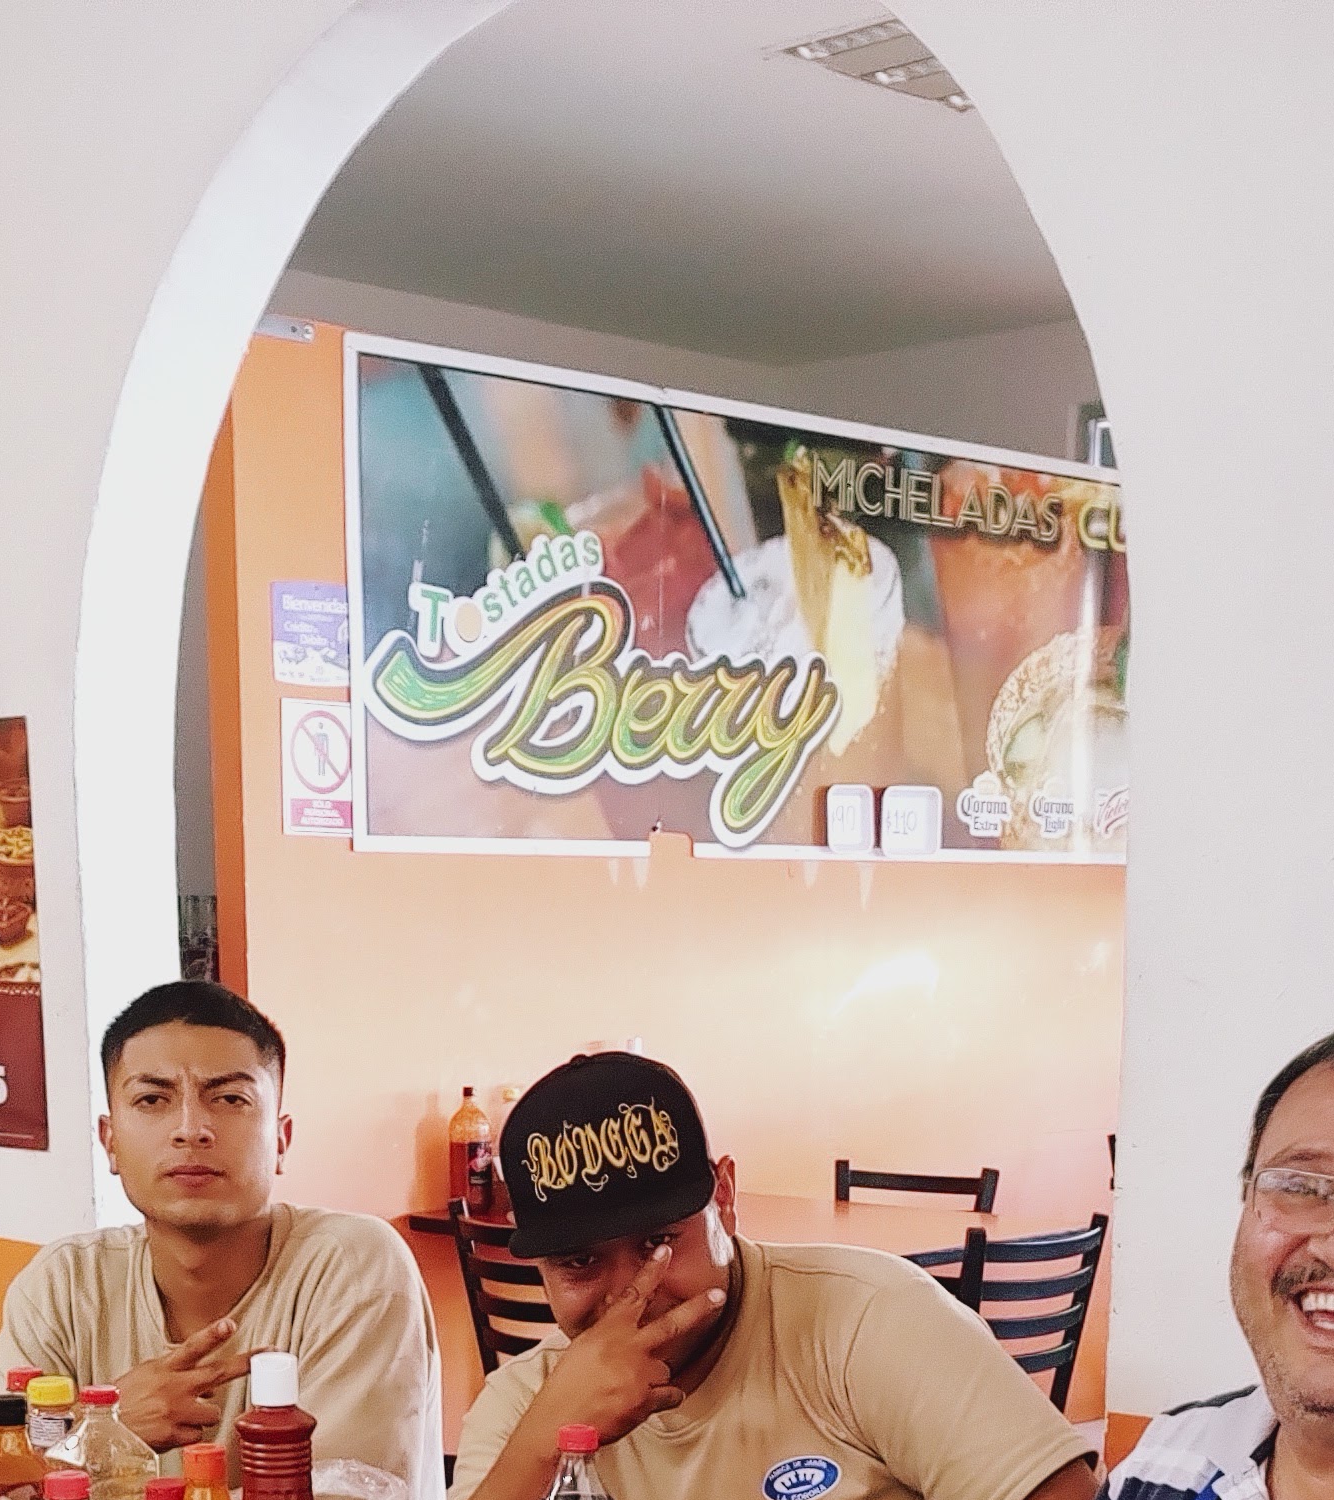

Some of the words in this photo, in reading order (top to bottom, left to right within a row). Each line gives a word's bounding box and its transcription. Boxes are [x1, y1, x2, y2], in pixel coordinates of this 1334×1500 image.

[812, 453, 1062, 542] MICHELADAS
[420, 535, 601, 643] Tostadas
[373, 588, 835, 831] Berry
[961, 794, 1009, 816] Corona
[973, 817, 998, 831] Extra
